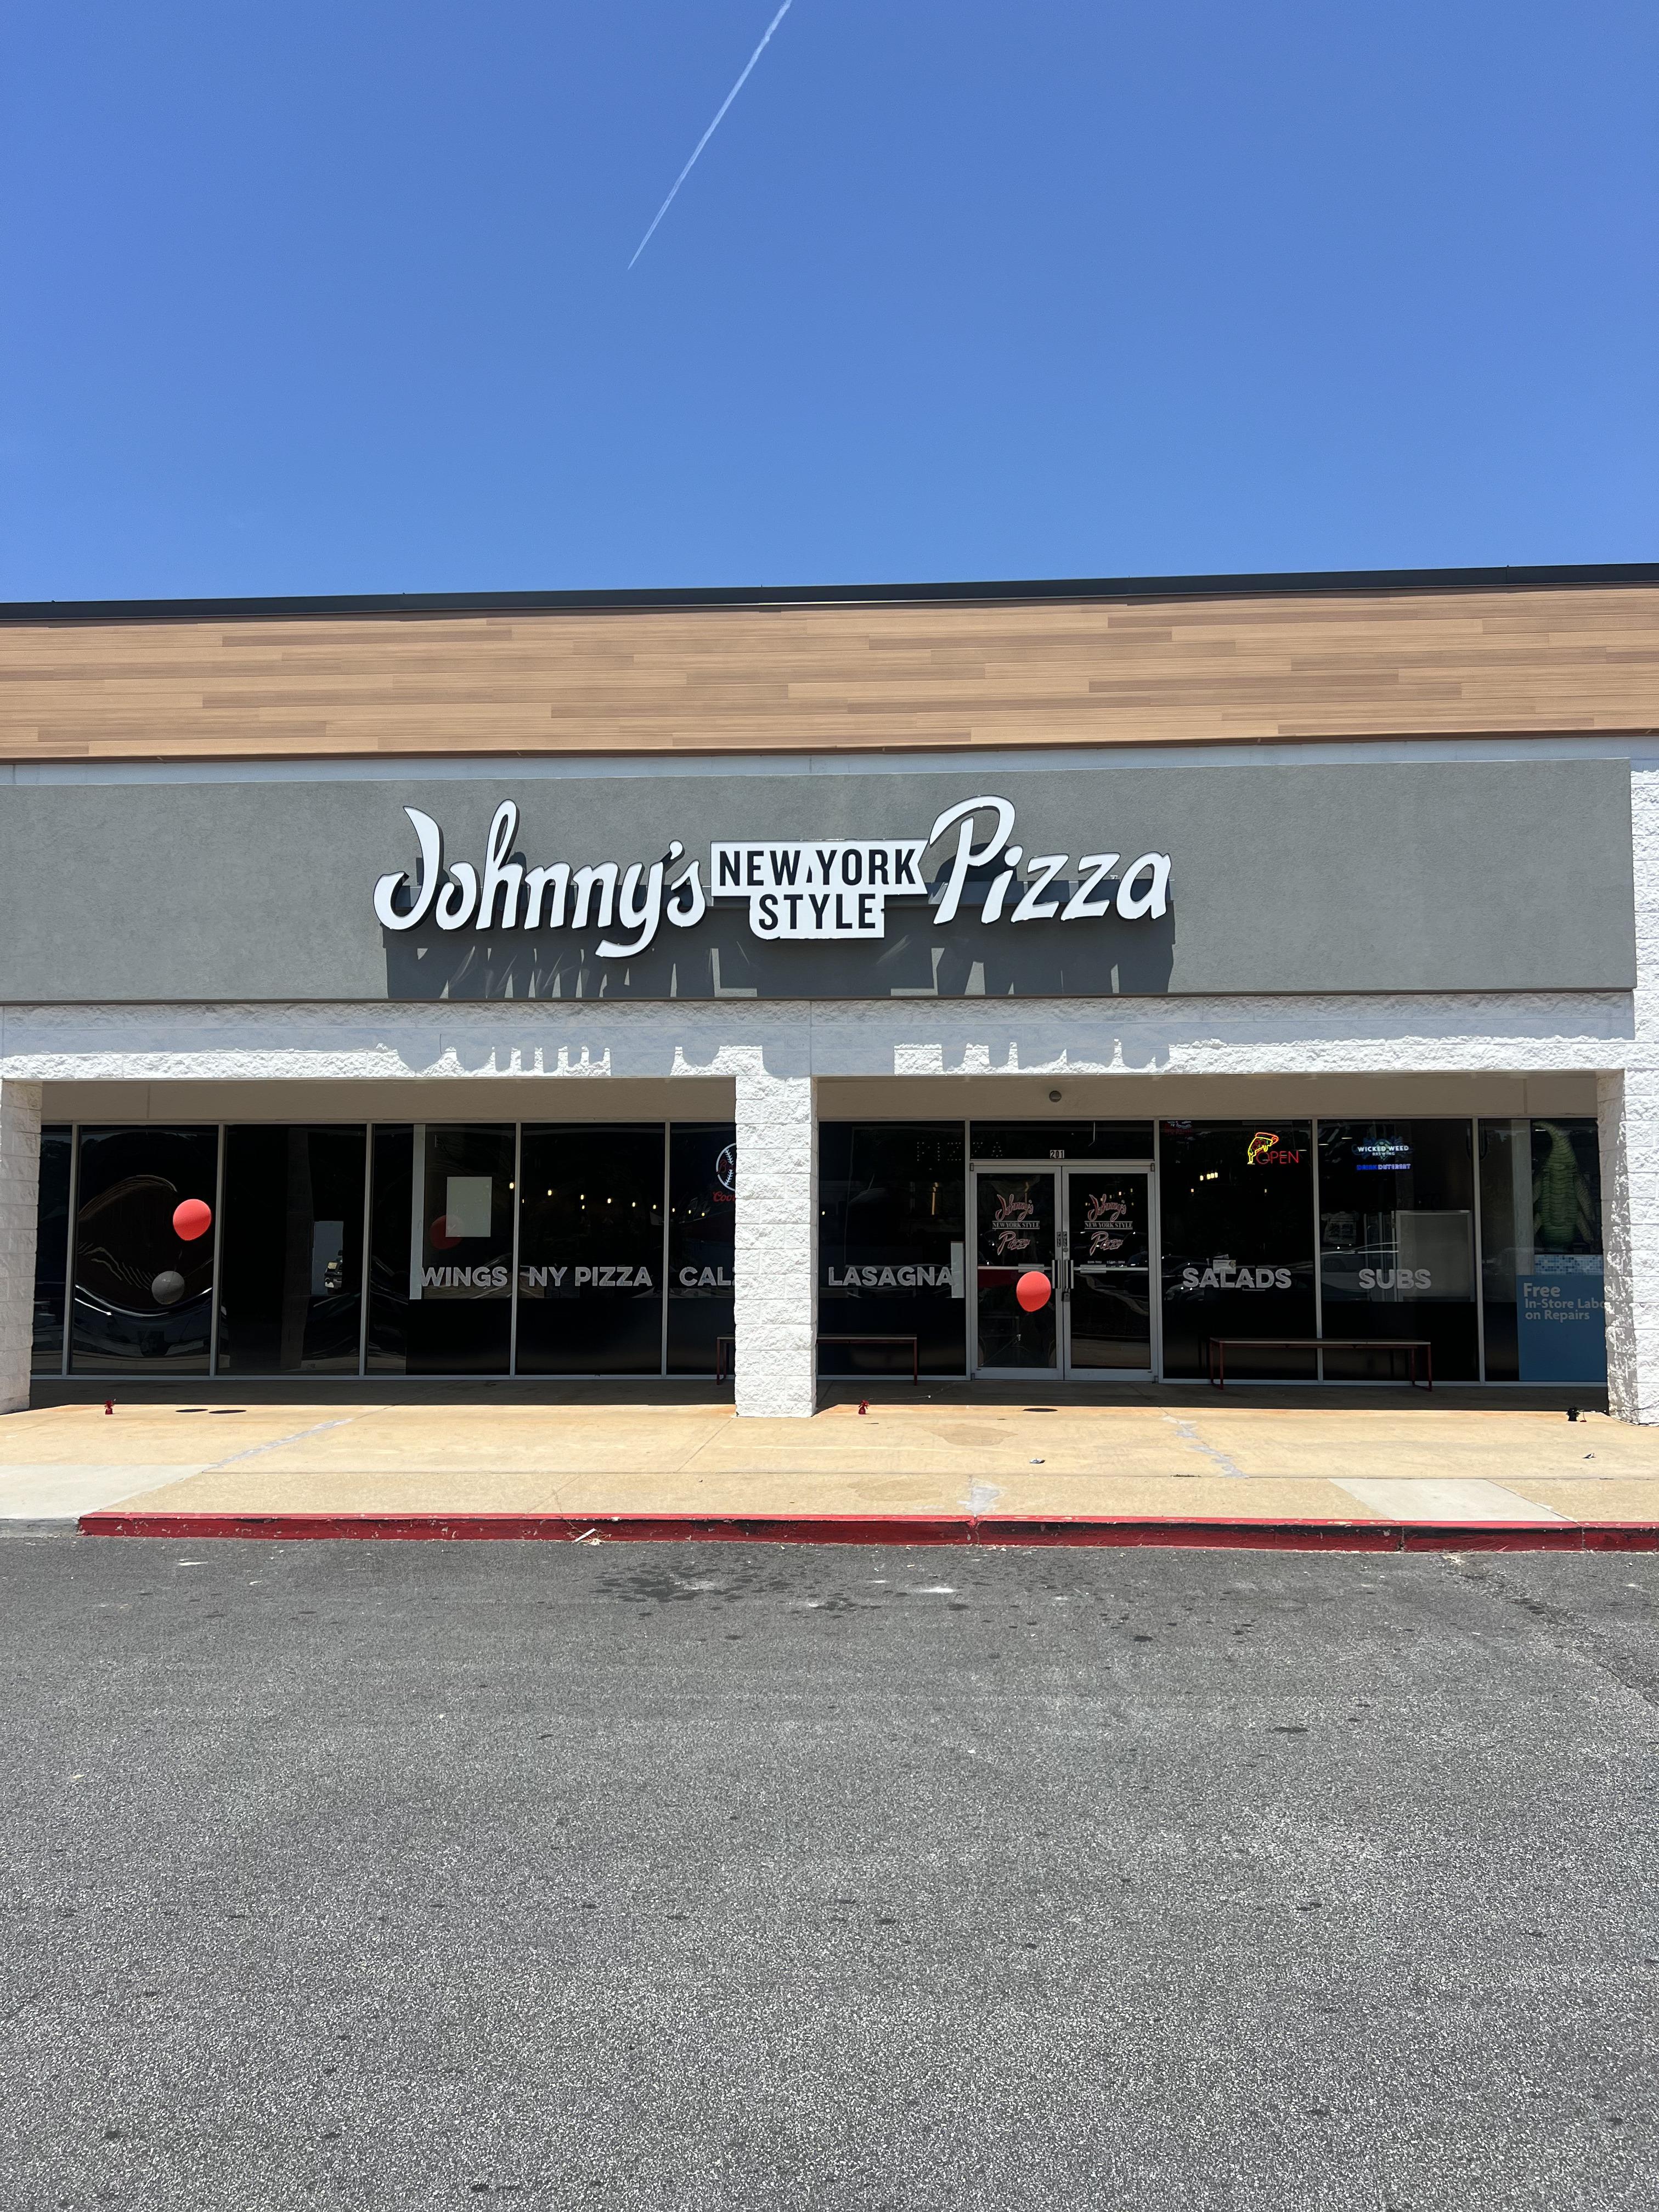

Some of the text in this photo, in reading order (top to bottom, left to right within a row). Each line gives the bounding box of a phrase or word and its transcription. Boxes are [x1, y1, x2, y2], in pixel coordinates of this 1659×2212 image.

[719, 849, 916, 886] NEW YORK
[929, 794, 1172, 924] Pizza
[374, 799, 706, 957] Johnny's
[759, 894, 876, 930] STYLE
[1050, 1150, 1065, 1159] 201
[1256, 1150, 1300, 1165] OPEN
[419, 1266, 508, 1286] WINGS
[529, 1267, 653, 1286] NY PIZZA
[828, 1266, 955, 1286] LASAGNA
[1182, 1267, 1292, 1289] SALADS
[1358, 1268, 1431, 1289] SUBS
[1523, 1283, 1561, 1297] Free
[1525, 1297, 1574, 1308] In-Store
[1525, 1310, 1590, 1323] on Repairs
